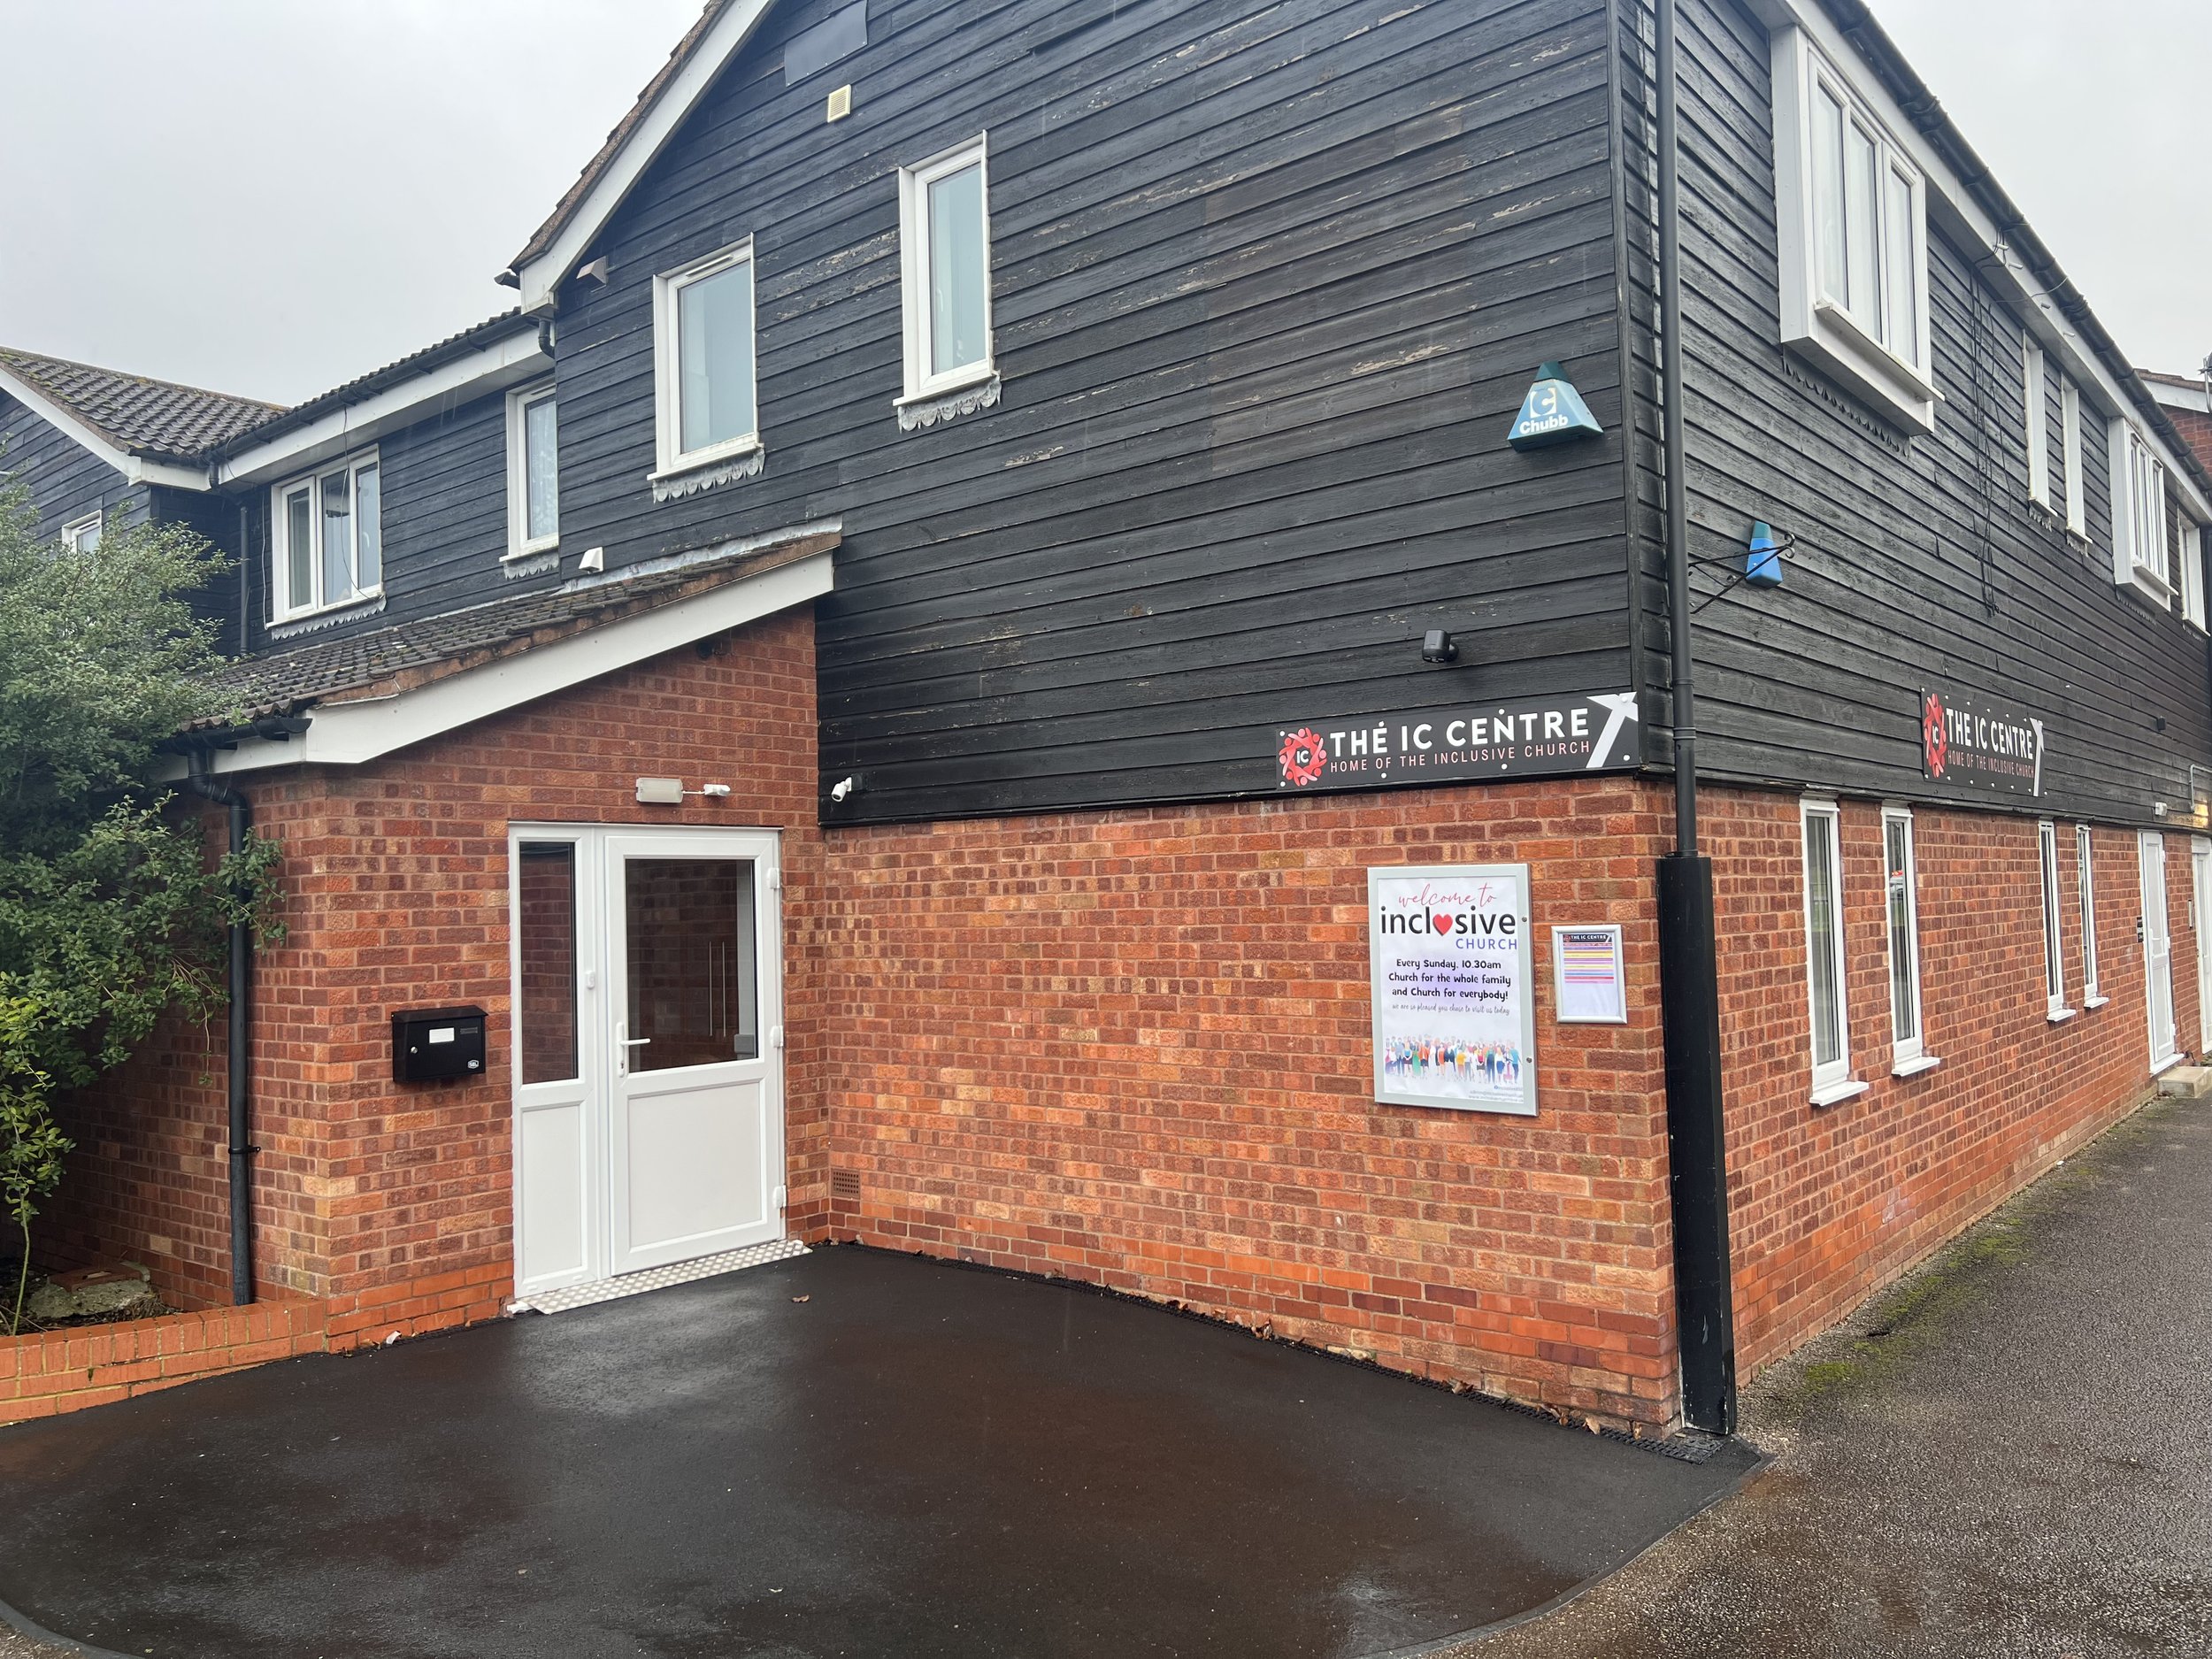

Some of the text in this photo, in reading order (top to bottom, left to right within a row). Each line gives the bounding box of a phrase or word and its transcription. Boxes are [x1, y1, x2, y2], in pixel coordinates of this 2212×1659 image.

[1519, 414, 1568, 434] Chubb
[1330, 708, 1589, 757] THE IC CENTRE
[1932, 726, 1939, 744] IC
[1946, 708, 2033, 760] THE IC CENTRE
[1296, 750, 1310, 764] IC
[1330, 741, 1590, 772] HOME OF THE INCLUSIVE CHURCH
[1947, 750, 2035, 779] HOME OF THE INCLUSIVE CHURCH
[1398, 882, 1498, 908] welcome to
[1455, 938, 1517, 949] CHURCH
[1396, 959, 1420, 970] Every
[1462, 960, 1502, 969] 10.30am
[1388, 972, 1511, 987] Church for the whole family
[1392, 987, 1508, 1002] and Church for everybody!
